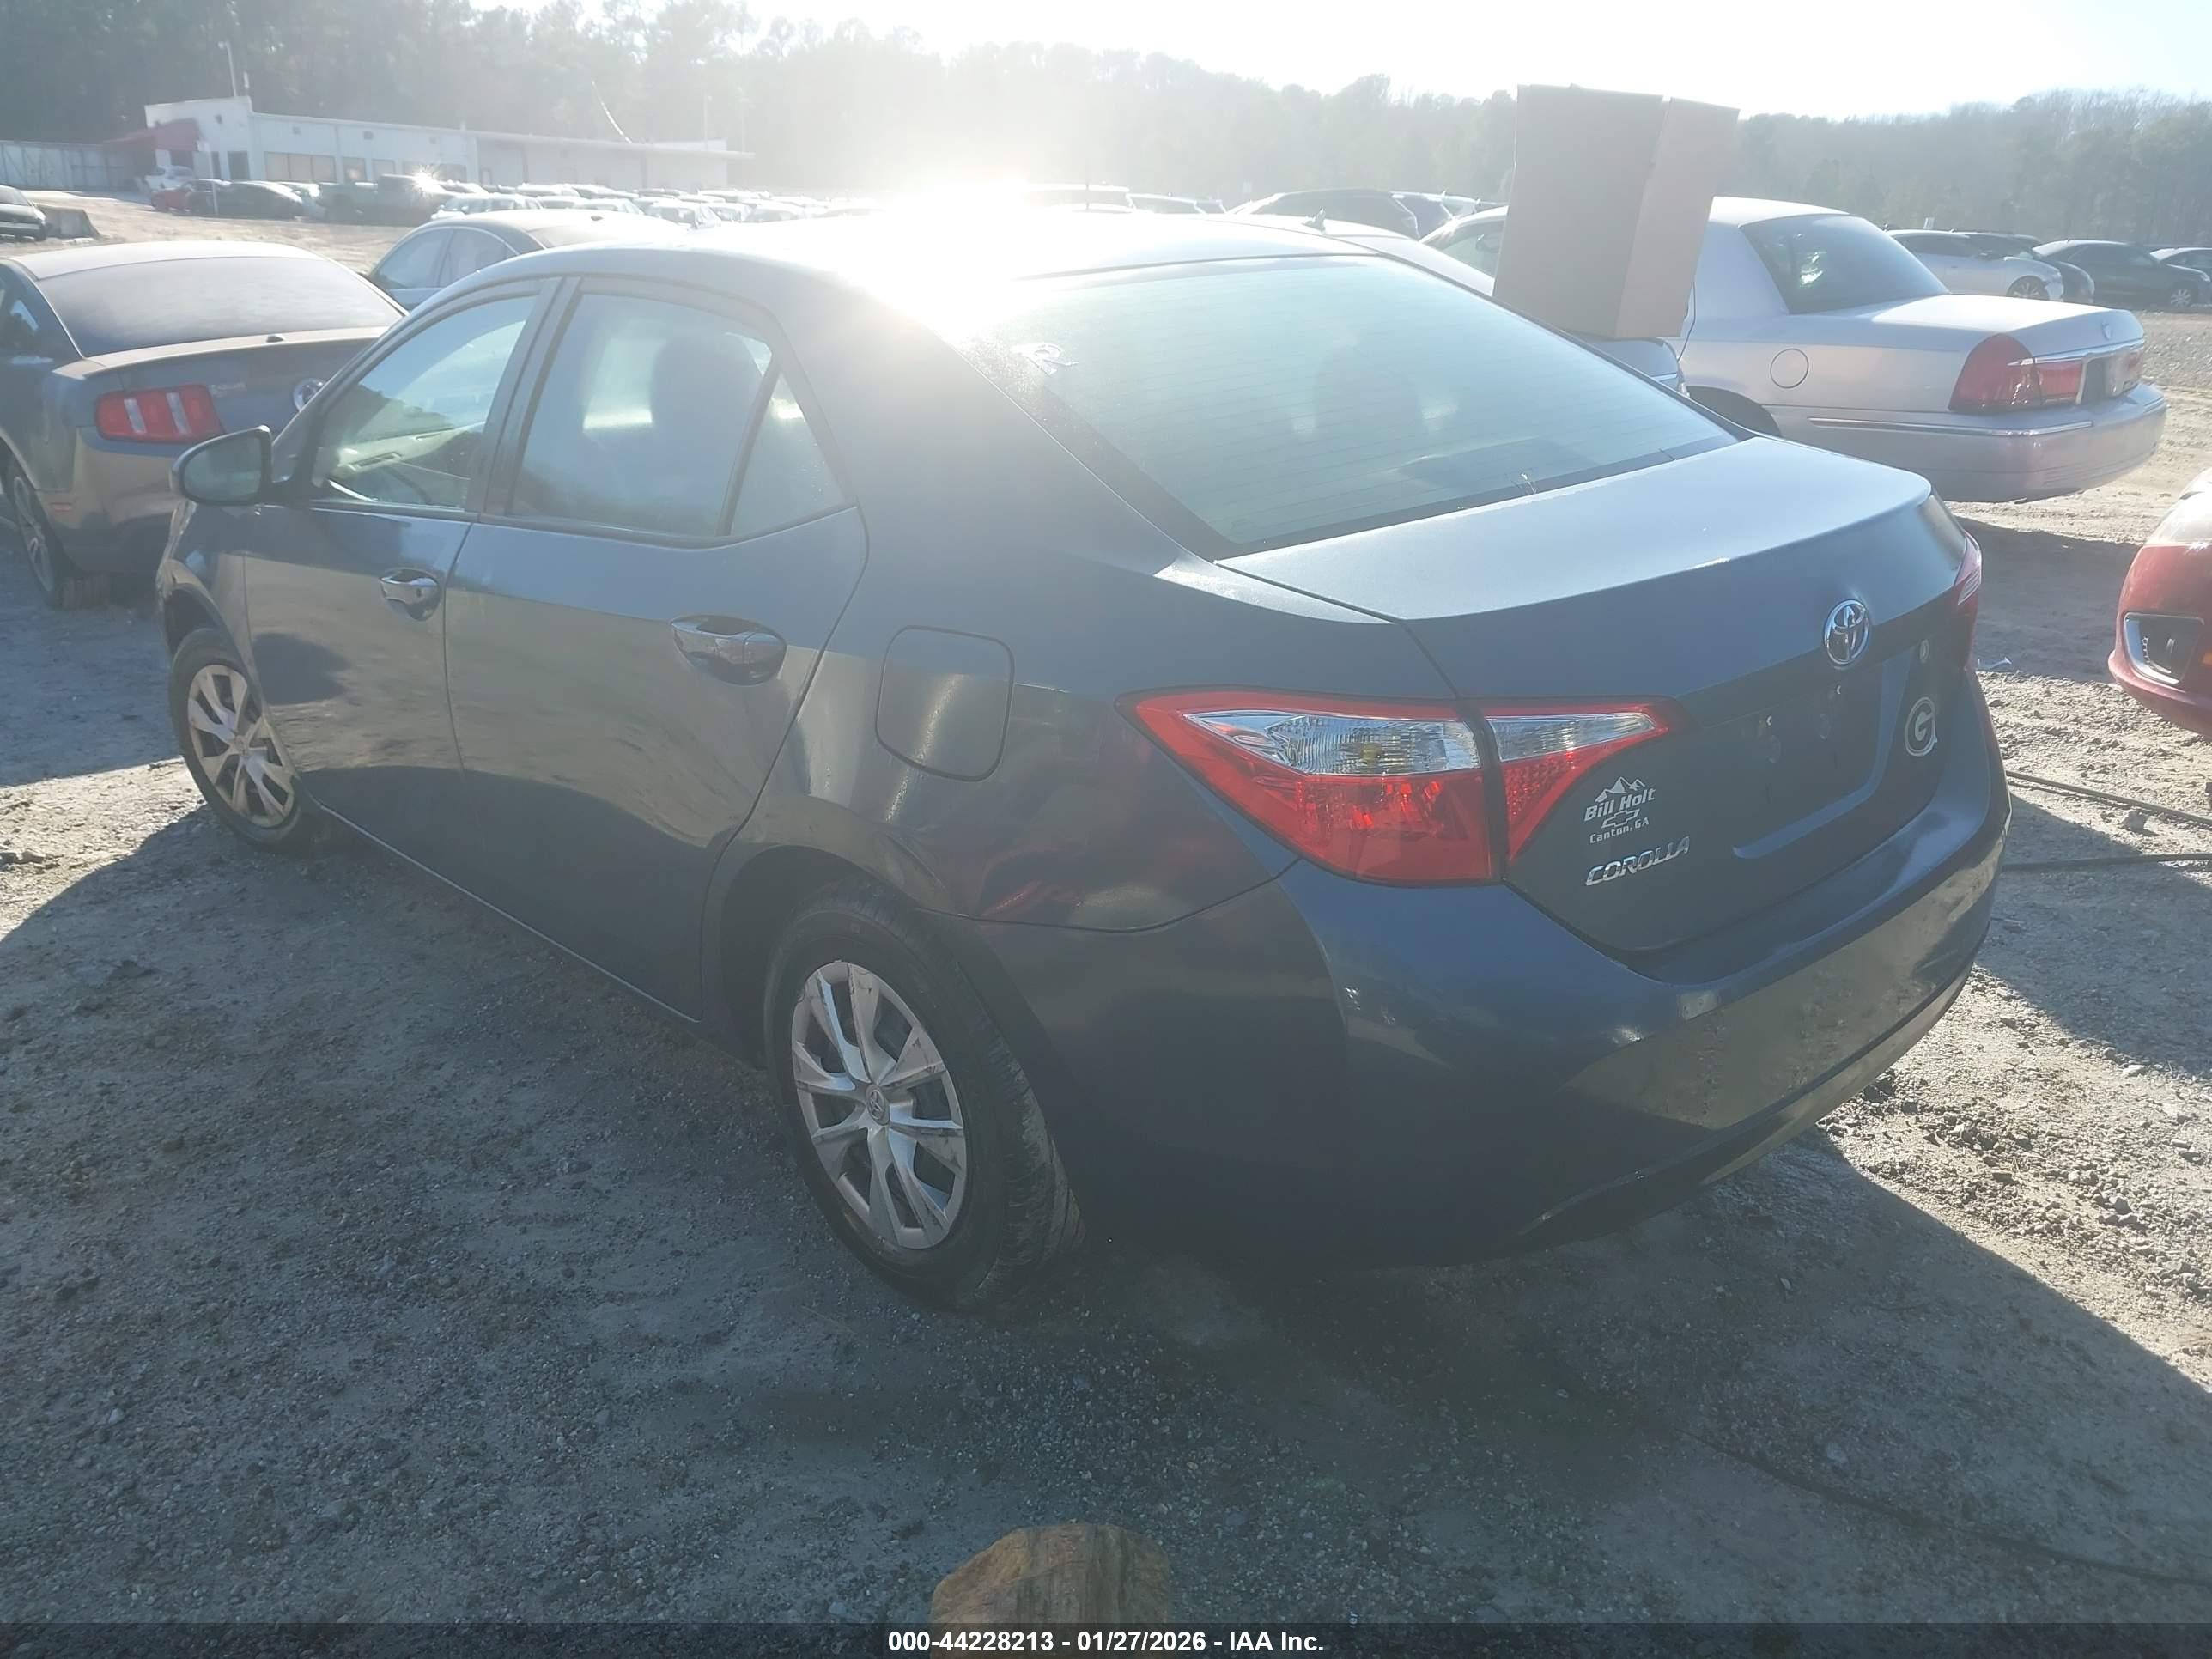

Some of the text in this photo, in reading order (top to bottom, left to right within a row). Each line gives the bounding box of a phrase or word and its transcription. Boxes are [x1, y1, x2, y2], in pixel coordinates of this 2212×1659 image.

[1905, 696, 1938, 757] G
[1584, 787, 1656, 821] Bill Holt
[1589, 817, 1650, 843] Canton, GA
[1586, 836, 1691, 886] COROLLA
